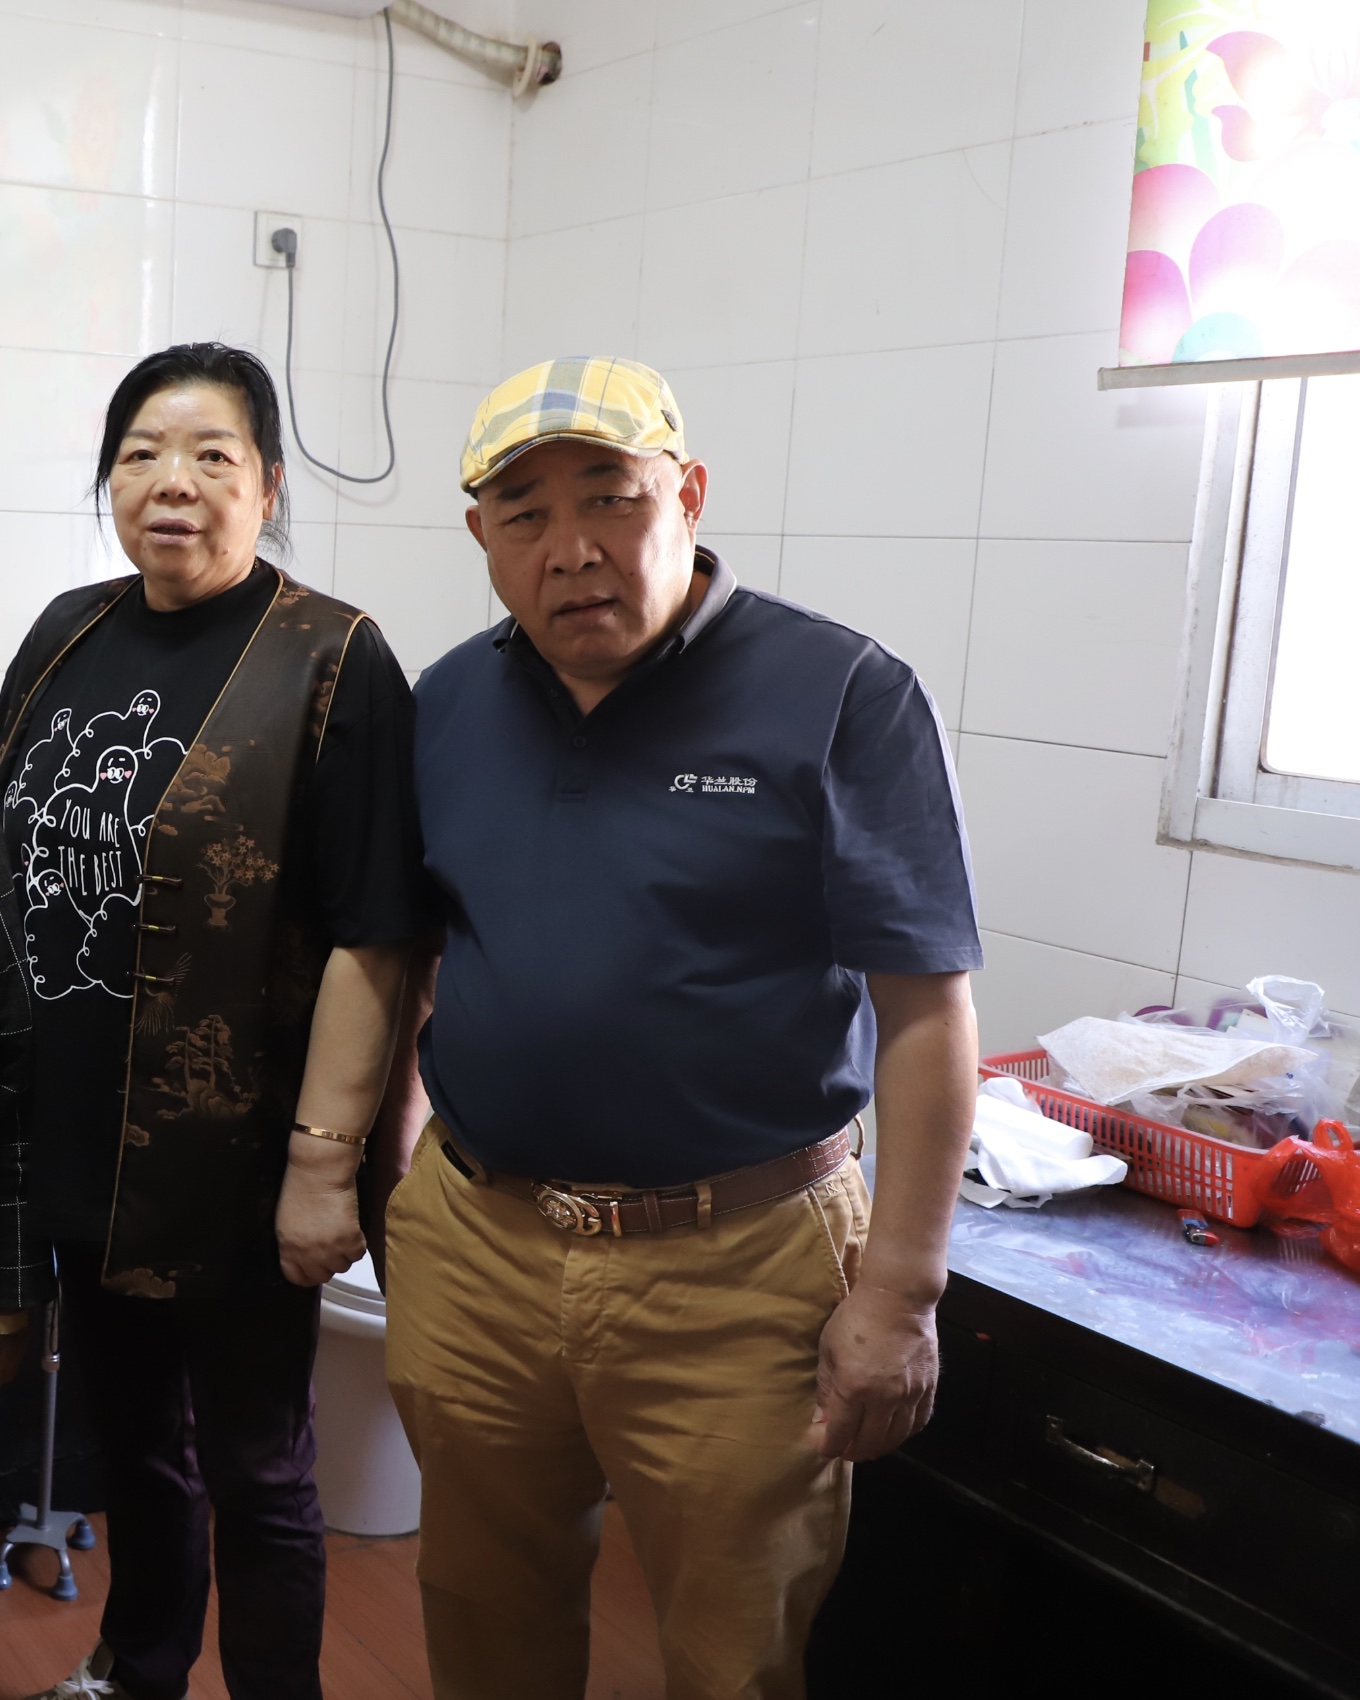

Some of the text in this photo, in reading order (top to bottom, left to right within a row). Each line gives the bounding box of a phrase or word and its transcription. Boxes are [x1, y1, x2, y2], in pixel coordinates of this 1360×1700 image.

[701, 776, 758, 787] 华兰股份
[60, 799, 120, 847] YOU ARE
[57, 846, 122, 896] THE BEST
